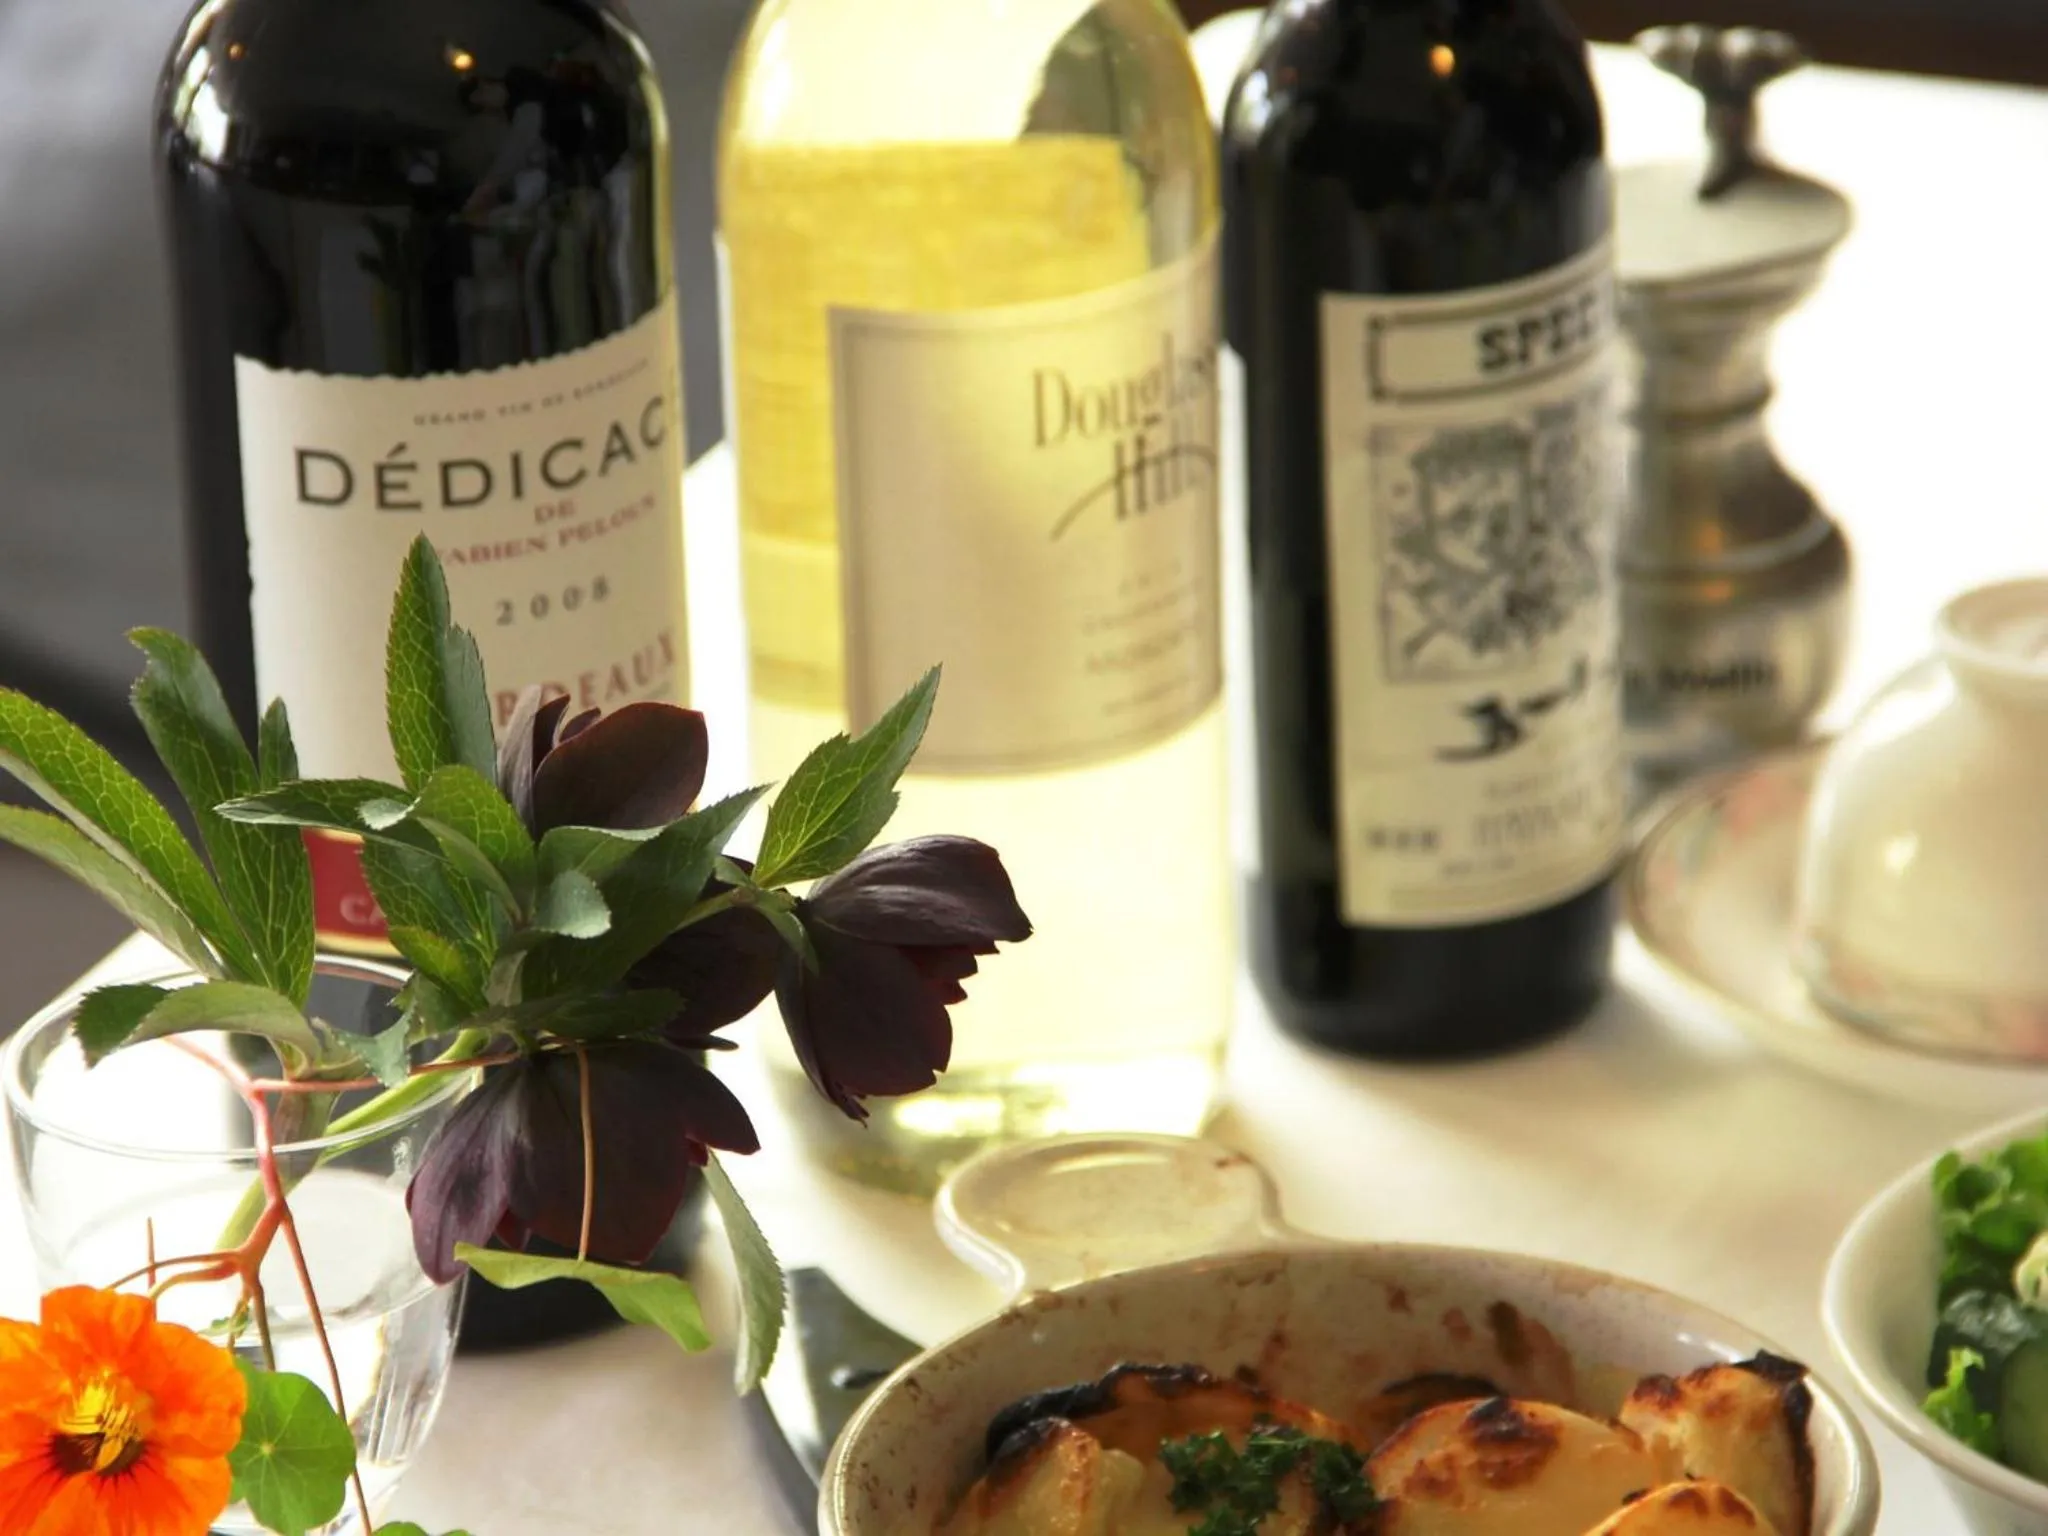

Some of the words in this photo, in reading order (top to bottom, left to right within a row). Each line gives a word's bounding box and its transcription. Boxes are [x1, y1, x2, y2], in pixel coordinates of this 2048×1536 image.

[533, 498, 577, 525] DE
[437, 533, 548, 566] ABIEN
[495, 575, 611, 627] 2008
[494, 631, 677, 727] RDEAUX
